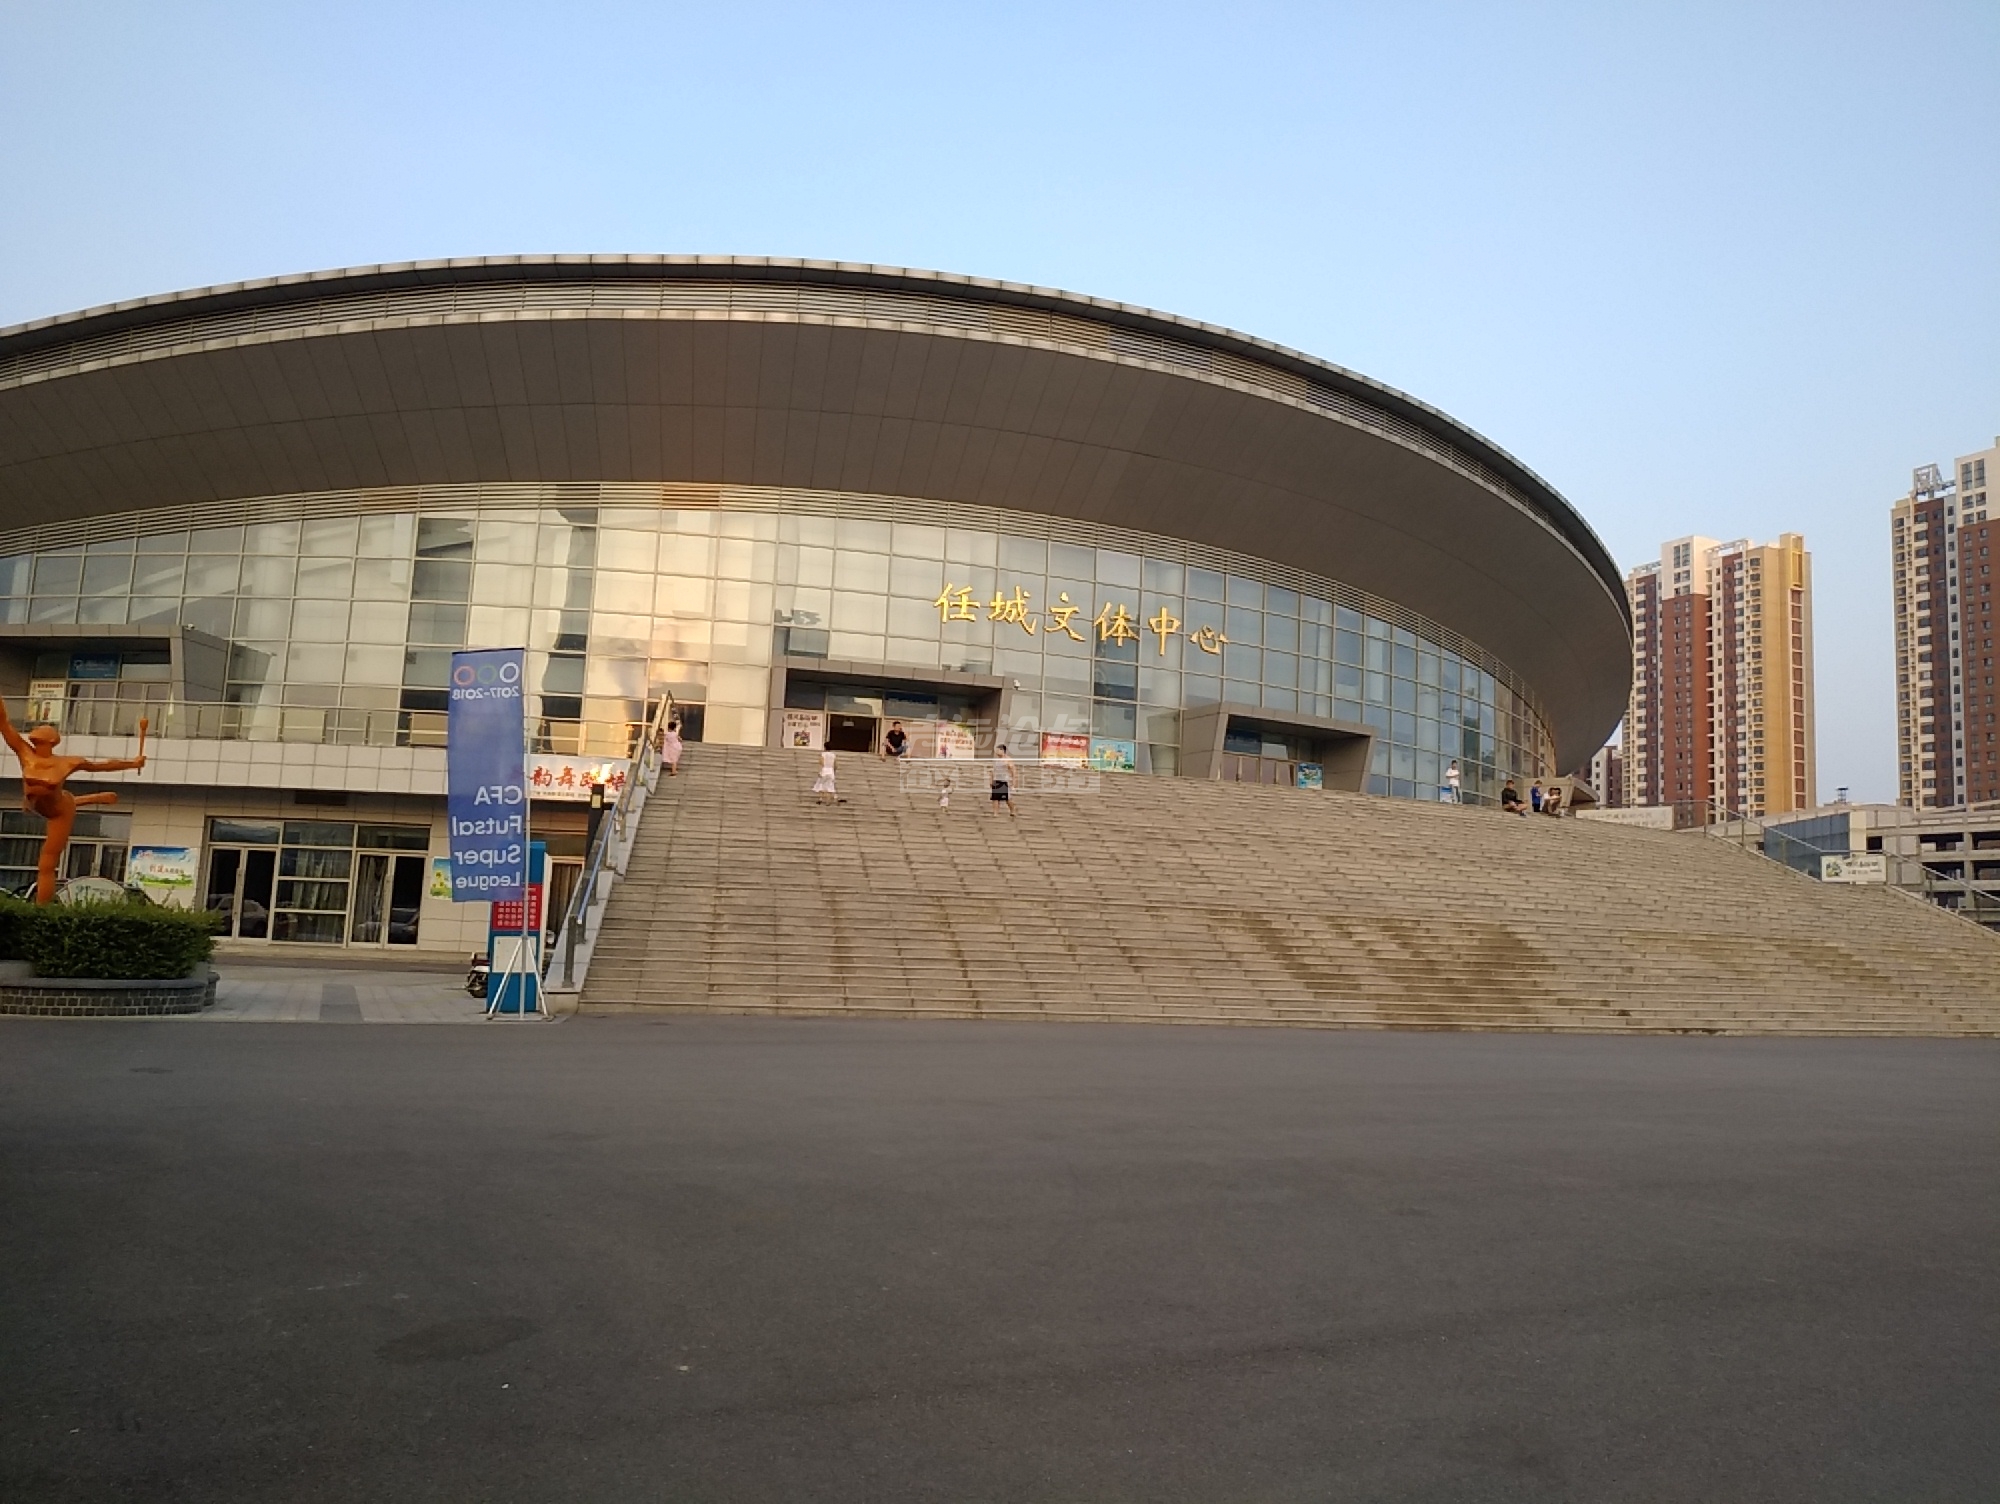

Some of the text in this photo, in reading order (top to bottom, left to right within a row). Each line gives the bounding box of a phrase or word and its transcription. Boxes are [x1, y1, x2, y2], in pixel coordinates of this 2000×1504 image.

[934, 582, 1229, 656] 任城文体中心
